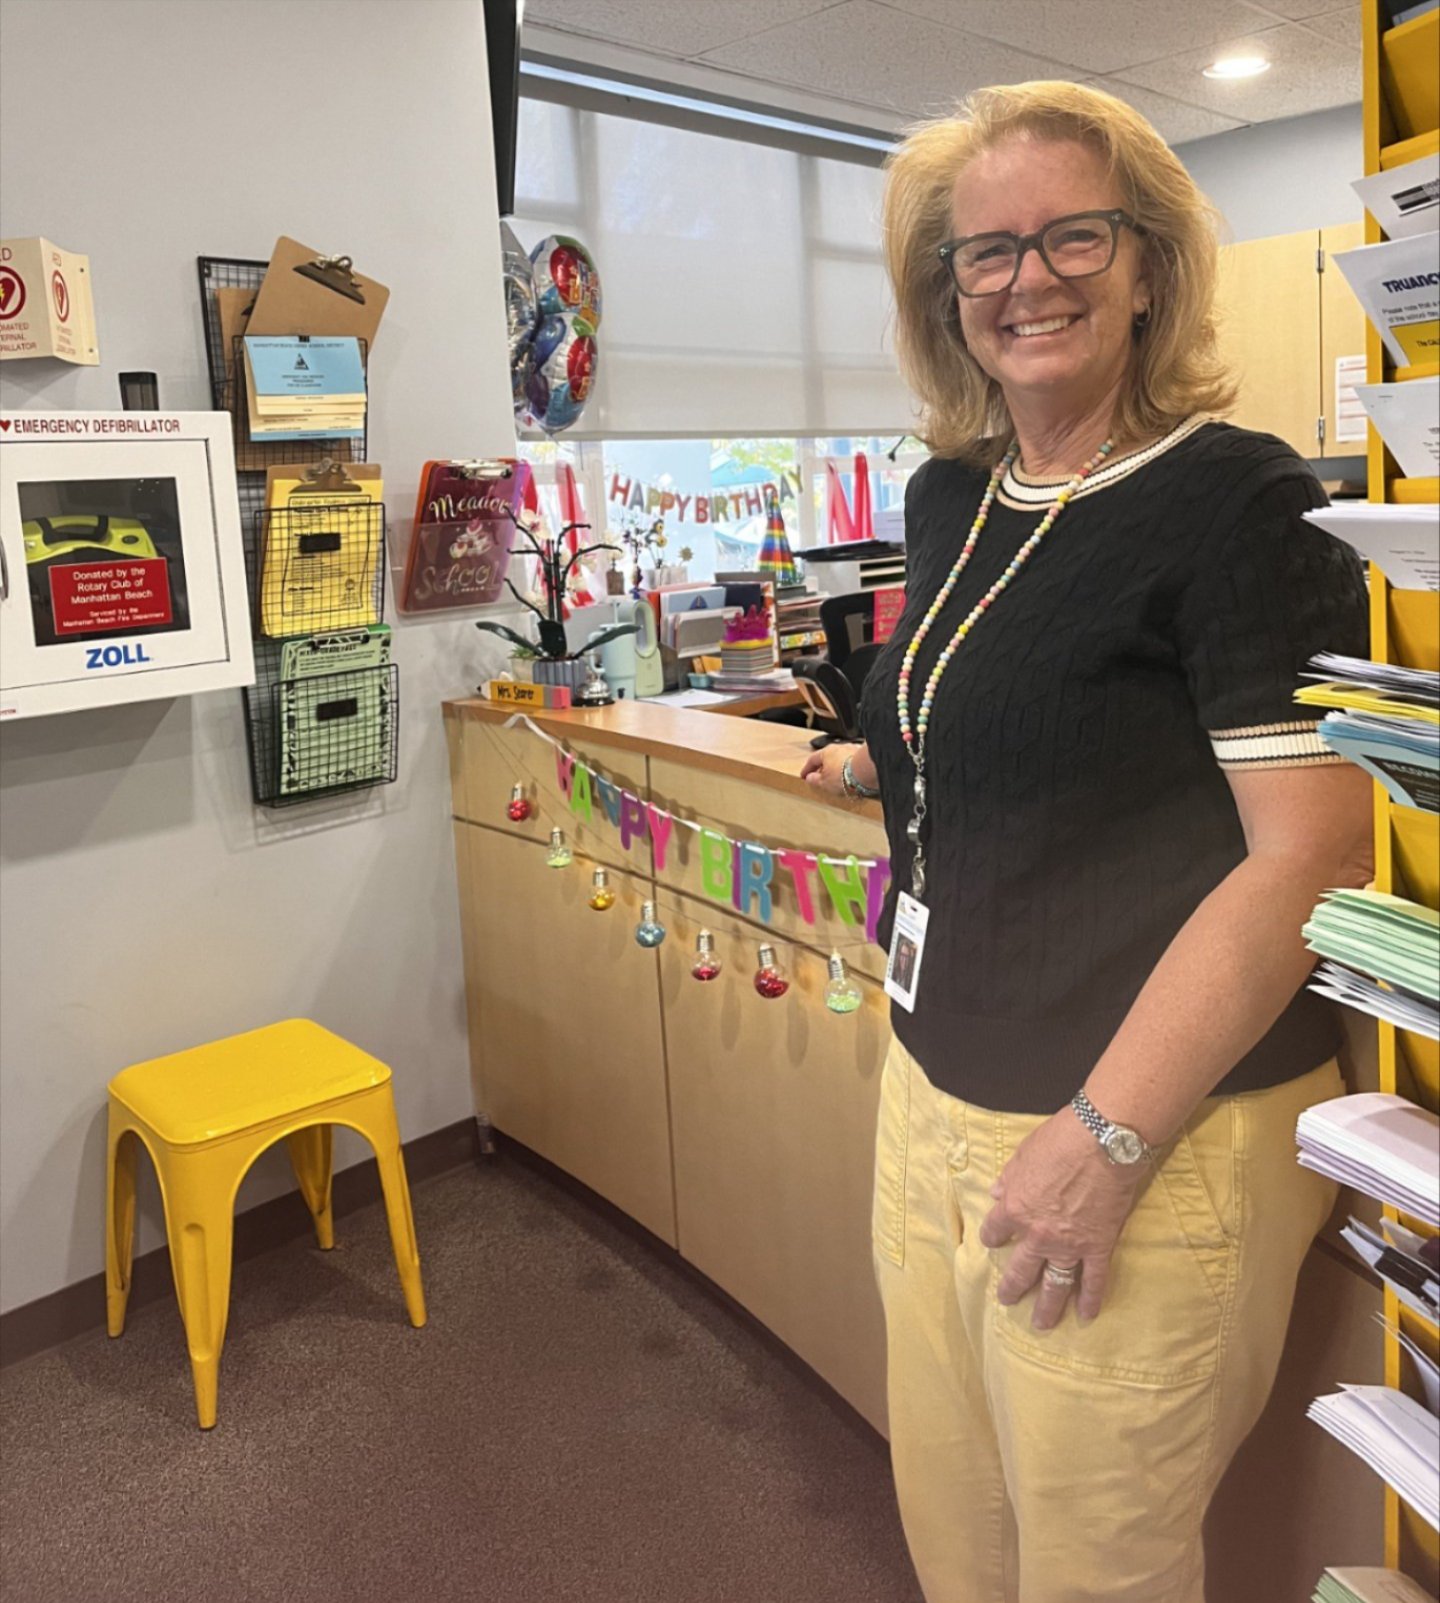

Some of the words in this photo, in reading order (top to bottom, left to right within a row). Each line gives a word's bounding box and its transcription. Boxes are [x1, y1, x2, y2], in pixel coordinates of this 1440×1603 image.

[14, 419, 89, 434] EMERGENCY
[93, 419, 181, 433] DEFIBRILLATOR
[609, 472, 692, 523] HAPPY
[73, 569, 113, 581] Donated
[116, 568, 127, 578] by
[130, 567, 146, 576] the
[414, 560, 501, 600] School
[77, 582, 107, 593] Rotary
[110, 579, 131, 589] Club
[134, 578, 144, 587] of
[71, 592, 121, 604] Manhattan
[125, 589, 153, 600] Beach
[86, 643, 151, 669] ZOLL
[555, 744, 672, 871] HAPPY
